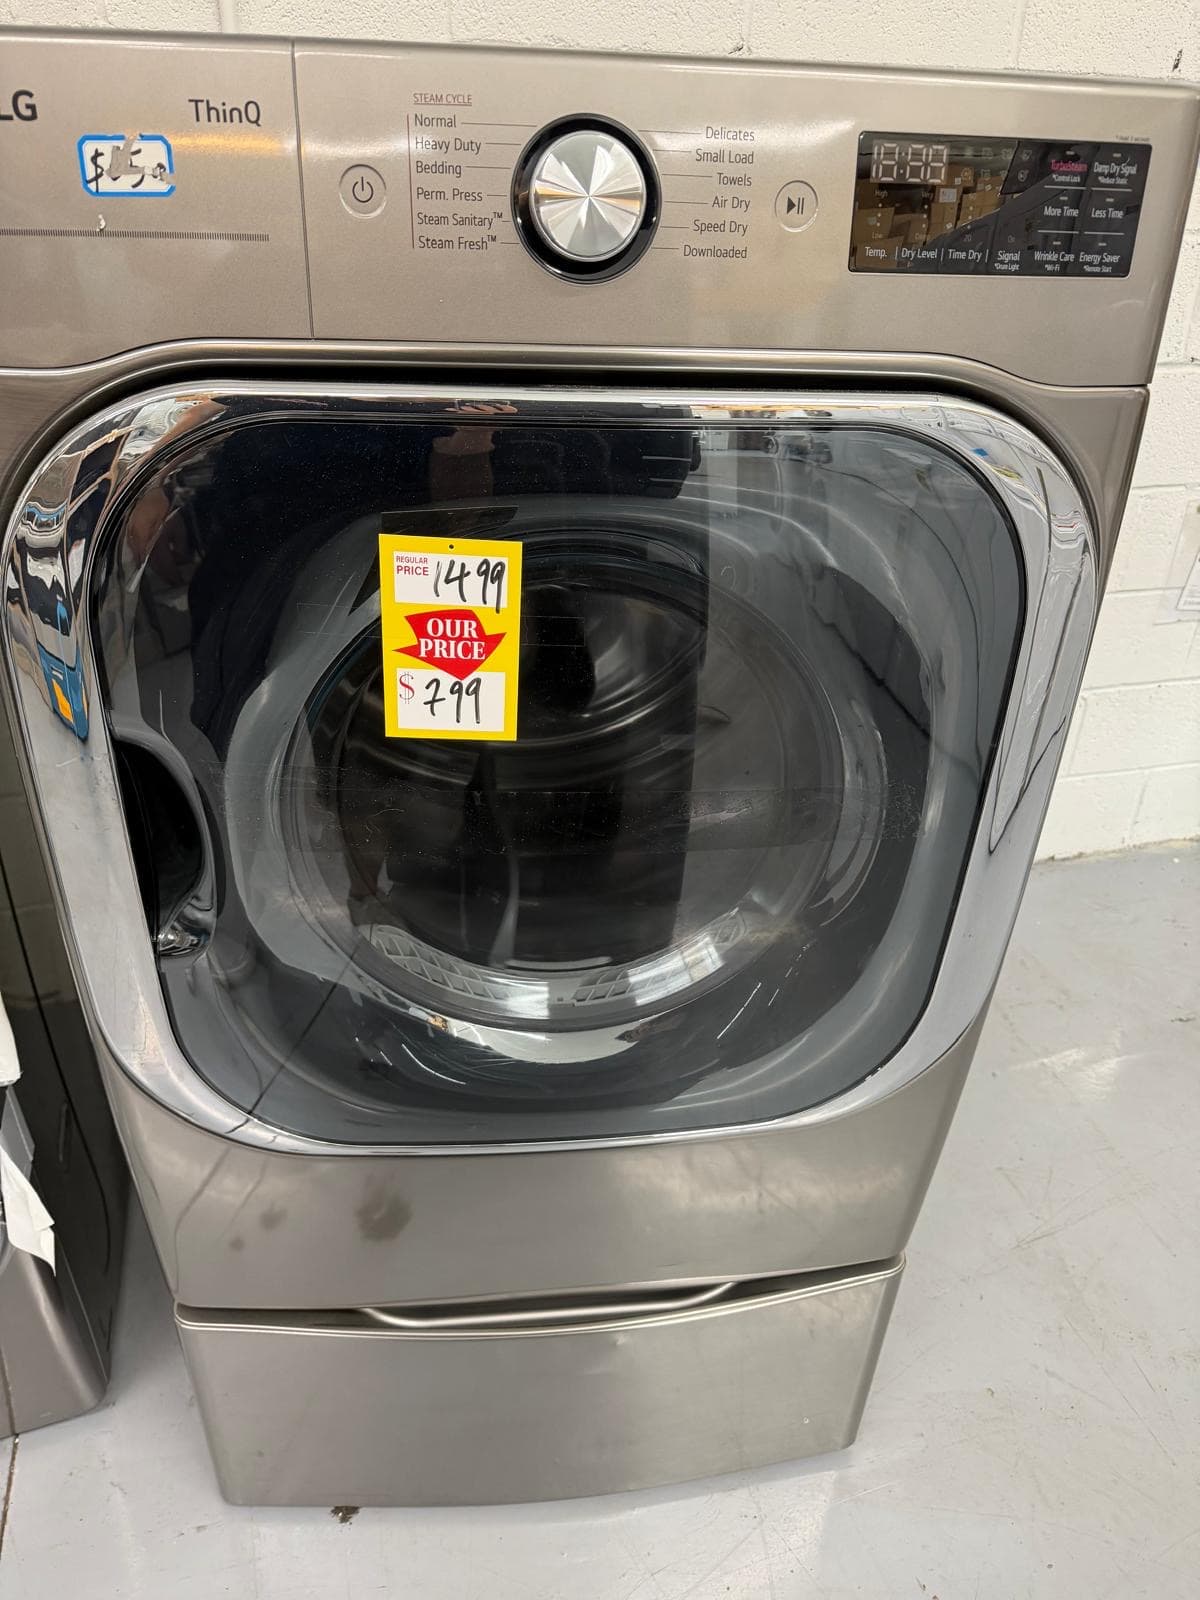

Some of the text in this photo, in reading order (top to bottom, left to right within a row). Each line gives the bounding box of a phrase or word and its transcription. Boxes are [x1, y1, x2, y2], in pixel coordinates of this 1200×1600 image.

[413, 93, 472, 104] STEAM CYCLE
[188, 99, 261, 127] ThinQ
[414, 113, 457, 128] Normal
[705, 126, 755, 142] Delicates
[415, 137, 482, 155] Heavy Duty
[695, 148, 755, 165] Small Load
[416, 161, 462, 178] Bedding
[1093, 162, 1138, 176] Damp Dry Signal
[717, 172, 752, 187] Towels
[416, 187, 483, 202] Perm. Press
[712, 196, 751, 212] Air Dry
[1044, 206, 1079, 217] More Time
[417, 212, 449, 225] Steam
[1091, 208, 1124, 219] Less Time
[693, 219, 748, 236] Speed Dry
[418, 235, 454, 249] Steam
[683, 244, 748, 259] Downloaded
[865, 246, 887, 258] Temp.
[901, 248, 938, 260] Dry Level
[948, 248, 982, 262] Time Dry
[997, 250, 1020, 263] Signal
[1034, 250, 1075, 262] Wrinkle Care
[1080, 252, 1120, 265] Energy Saver
[396, 555, 428, 564] REGULAR
[396, 565, 429, 576] PRICE
[433, 558, 506, 614] 1499
[426, 617, 478, 639] OUR
[419, 638, 486, 660] PRICE
[399, 672, 482, 724] $ 799
